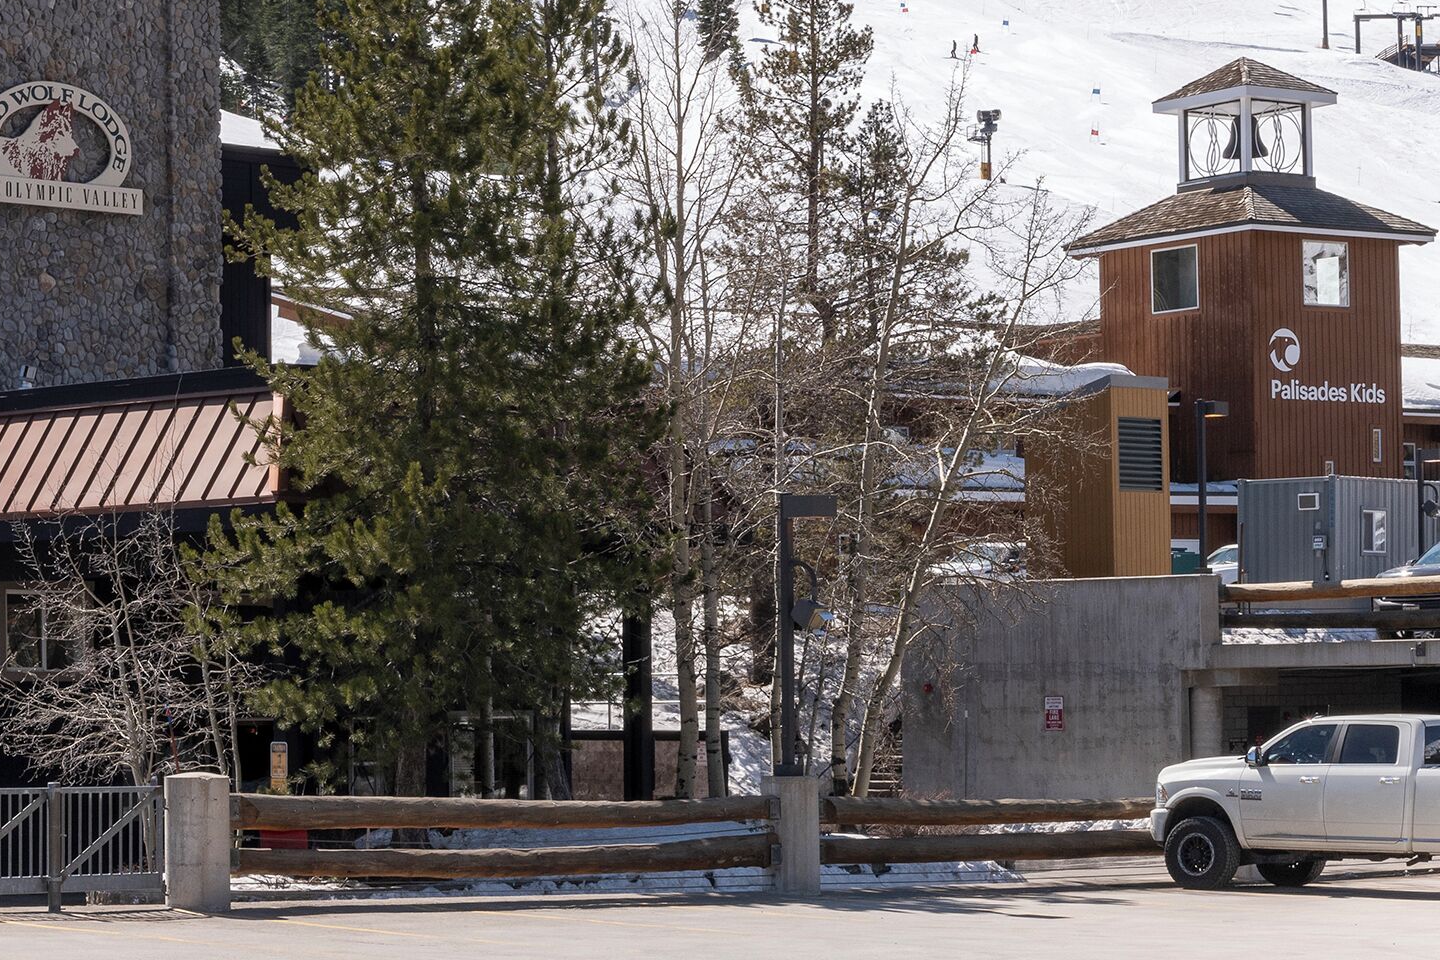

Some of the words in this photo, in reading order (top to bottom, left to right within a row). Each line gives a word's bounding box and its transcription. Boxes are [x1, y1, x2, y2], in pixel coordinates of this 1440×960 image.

[9, 85, 75, 107] WOLF
[78, 94, 127, 173] LODGE
[5, 181, 73, 203] OLYMPIC
[83, 189, 138, 210] VALLEY
[1271, 379, 1348, 402] Palisades
[1350, 383, 1386, 404] Kids
